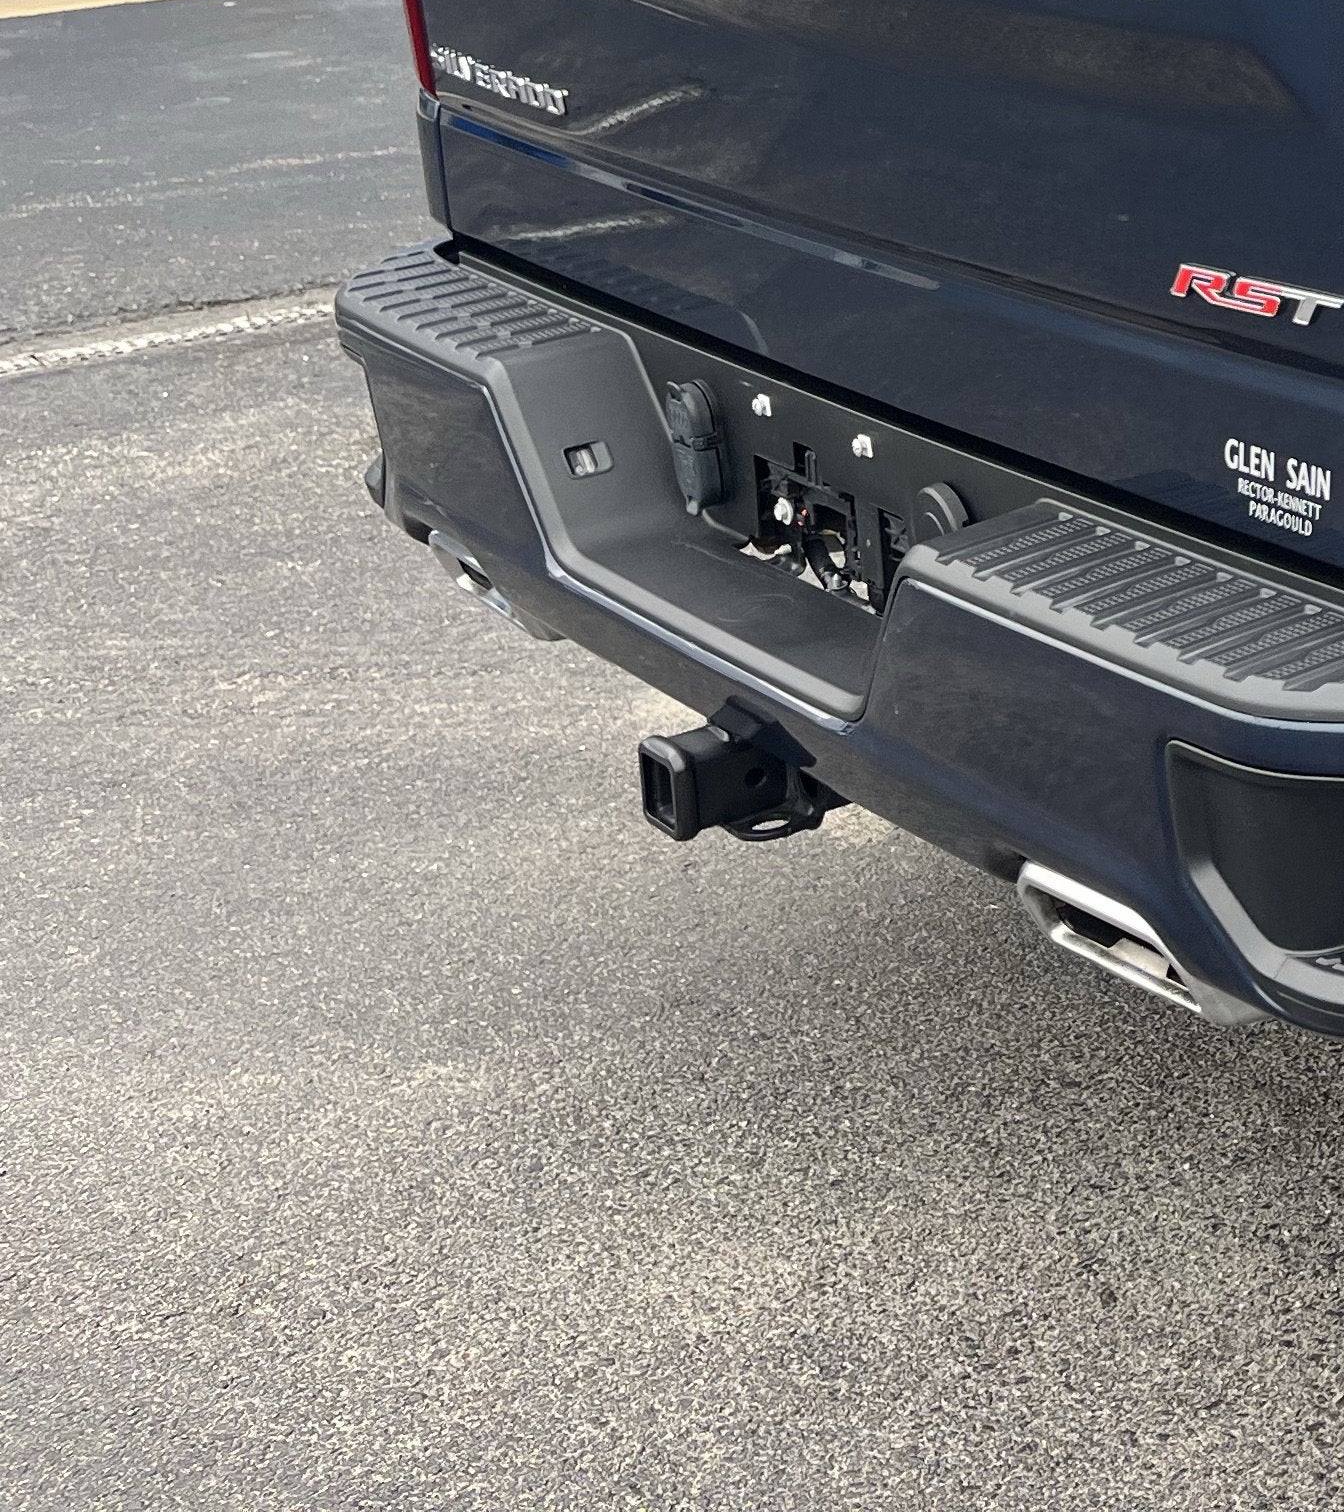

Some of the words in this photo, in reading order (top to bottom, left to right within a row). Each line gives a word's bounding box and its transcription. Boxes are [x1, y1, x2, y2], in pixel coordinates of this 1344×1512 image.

[430, 43, 570, 116] SILVERADO
[1223, 438, 1276, 482] GLEN
[1285, 458, 1332, 502] SAIN
[1236, 477, 1323, 521] RECTOR-KENNETT
[1248, 499, 1313, 537] PARAGOULD
